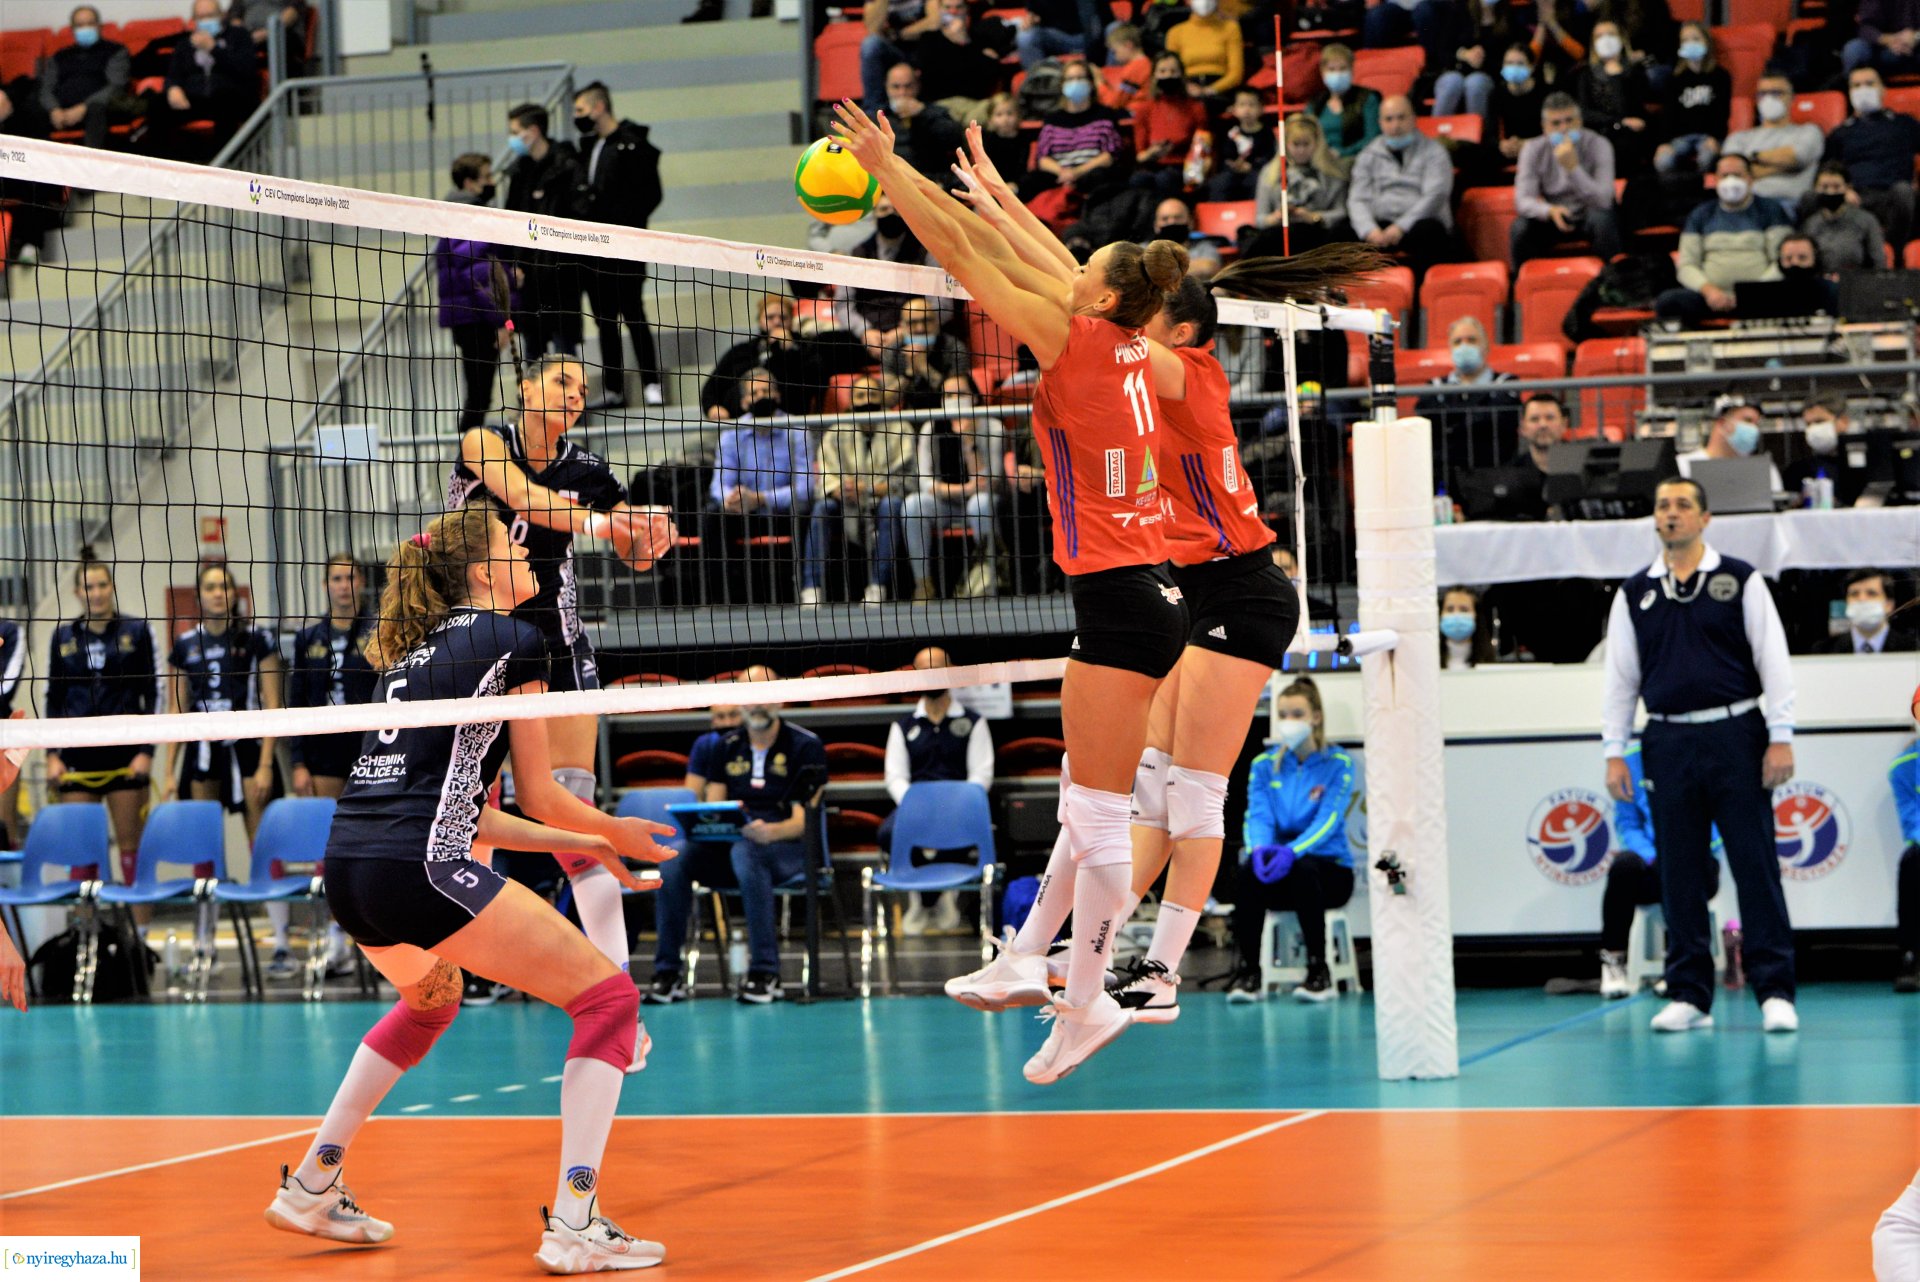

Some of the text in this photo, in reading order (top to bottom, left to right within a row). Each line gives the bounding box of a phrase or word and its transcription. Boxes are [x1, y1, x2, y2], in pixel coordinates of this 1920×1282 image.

[11, 151, 26, 162] 2022
[264, 188, 276, 199] CEV
[276, 190, 305, 203] Champions
[305, 194, 323, 207] League
[338, 199, 350, 209] 2022
[540, 226, 549, 236] CEV
[549, 228, 572, 240] Champions
[573, 232, 588, 242] League
[600, 234, 610, 244] 2022
[766, 255, 774, 264] CEV
[774, 257, 793, 267] Champions
[793, 260, 806, 270] League
[1122, 368, 1155, 437] 11
[1111, 451, 1120, 494] STRABAG
[207, 660, 221, 689] 3
[358, 753, 407, 767] CHEMIK
[452, 867, 479, 888] 5
